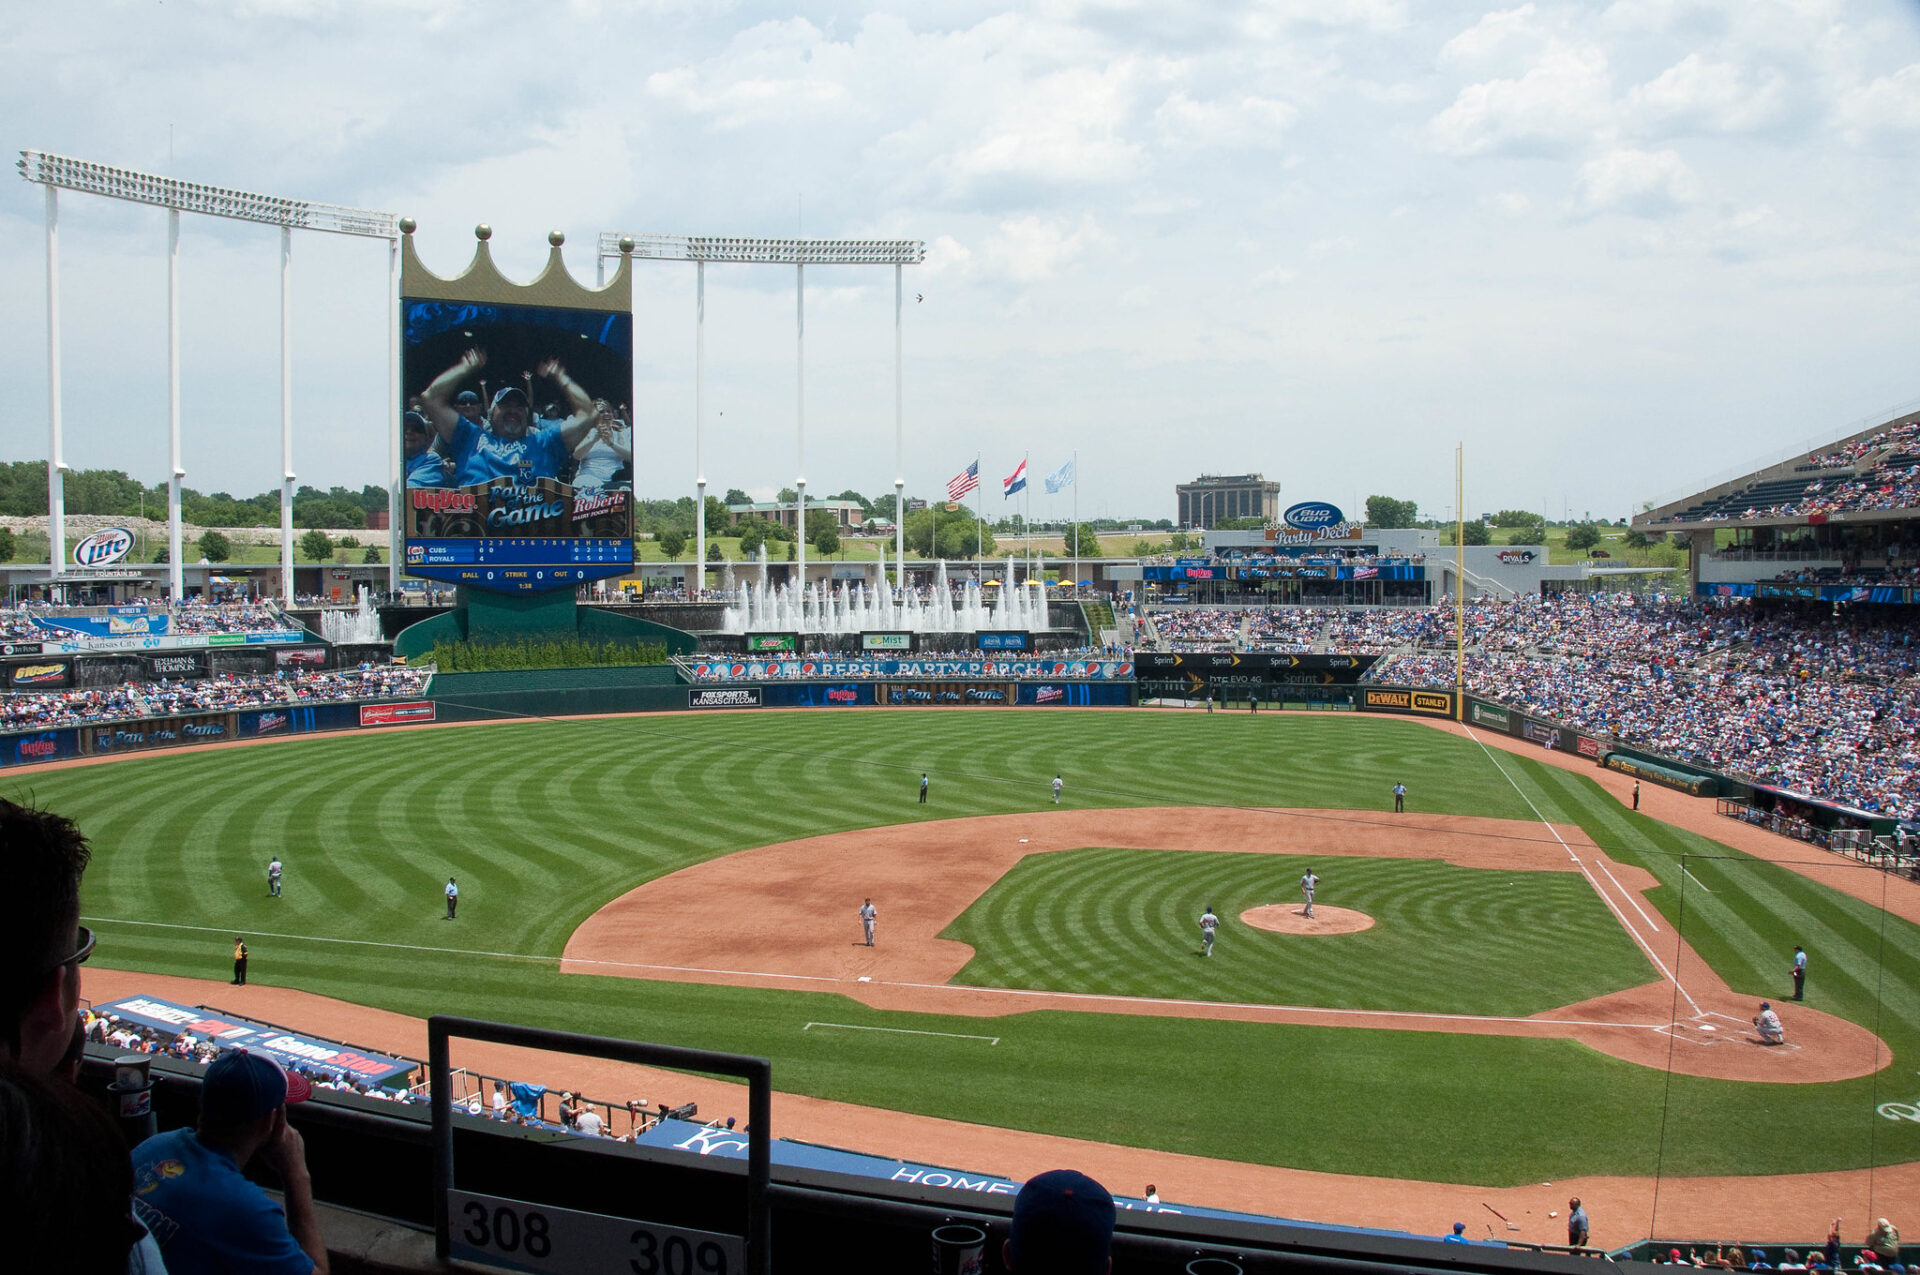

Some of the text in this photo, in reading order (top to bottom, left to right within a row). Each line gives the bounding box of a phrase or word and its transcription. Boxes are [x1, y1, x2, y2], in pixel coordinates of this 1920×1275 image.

[490, 485, 527, 502] Fan
[524, 494, 544, 505] the
[573, 494, 625, 514] Roberts
[487, 499, 565, 528] Game
[1274, 524, 1351, 547] Party Deck
[87, 538, 127, 564] Lite
[487, 572, 494, 580] 0
[536, 571, 543, 579] 0
[577, 571, 584, 579] 0
[1250, 568, 1270, 577] Fan
[1296, 568, 1327, 577] Game
[88, 640, 137, 650] Kansas City
[209, 636, 244, 644] Neuroscience
[882, 636, 902, 644] Mist
[1154, 657, 1174, 666] Sprint
[1212, 657, 1231, 666] Sprint
[1270, 658, 1290, 667] Sprint
[1329, 658, 1350, 668] Sprint
[155, 664, 195, 672] THOMPSON
[823, 663, 880, 675] PEPSI
[899, 663, 962, 675] PARTY
[1140, 676, 1185, 694] Sprint
[1231, 675, 1251, 683] EVO
[1250, 675, 1262, 683] 4G
[905, 689, 931, 700] Fan
[965, 688, 1004, 700] Game
[1417, 695, 1446, 707] STANLEY
[115, 731, 144, 745] Fan
[182, 723, 225, 737] Game
[262, 1036, 394, 1075] GameStop
[463, 1201, 552, 1258] 308
[629, 1230, 728, 1275] 309
